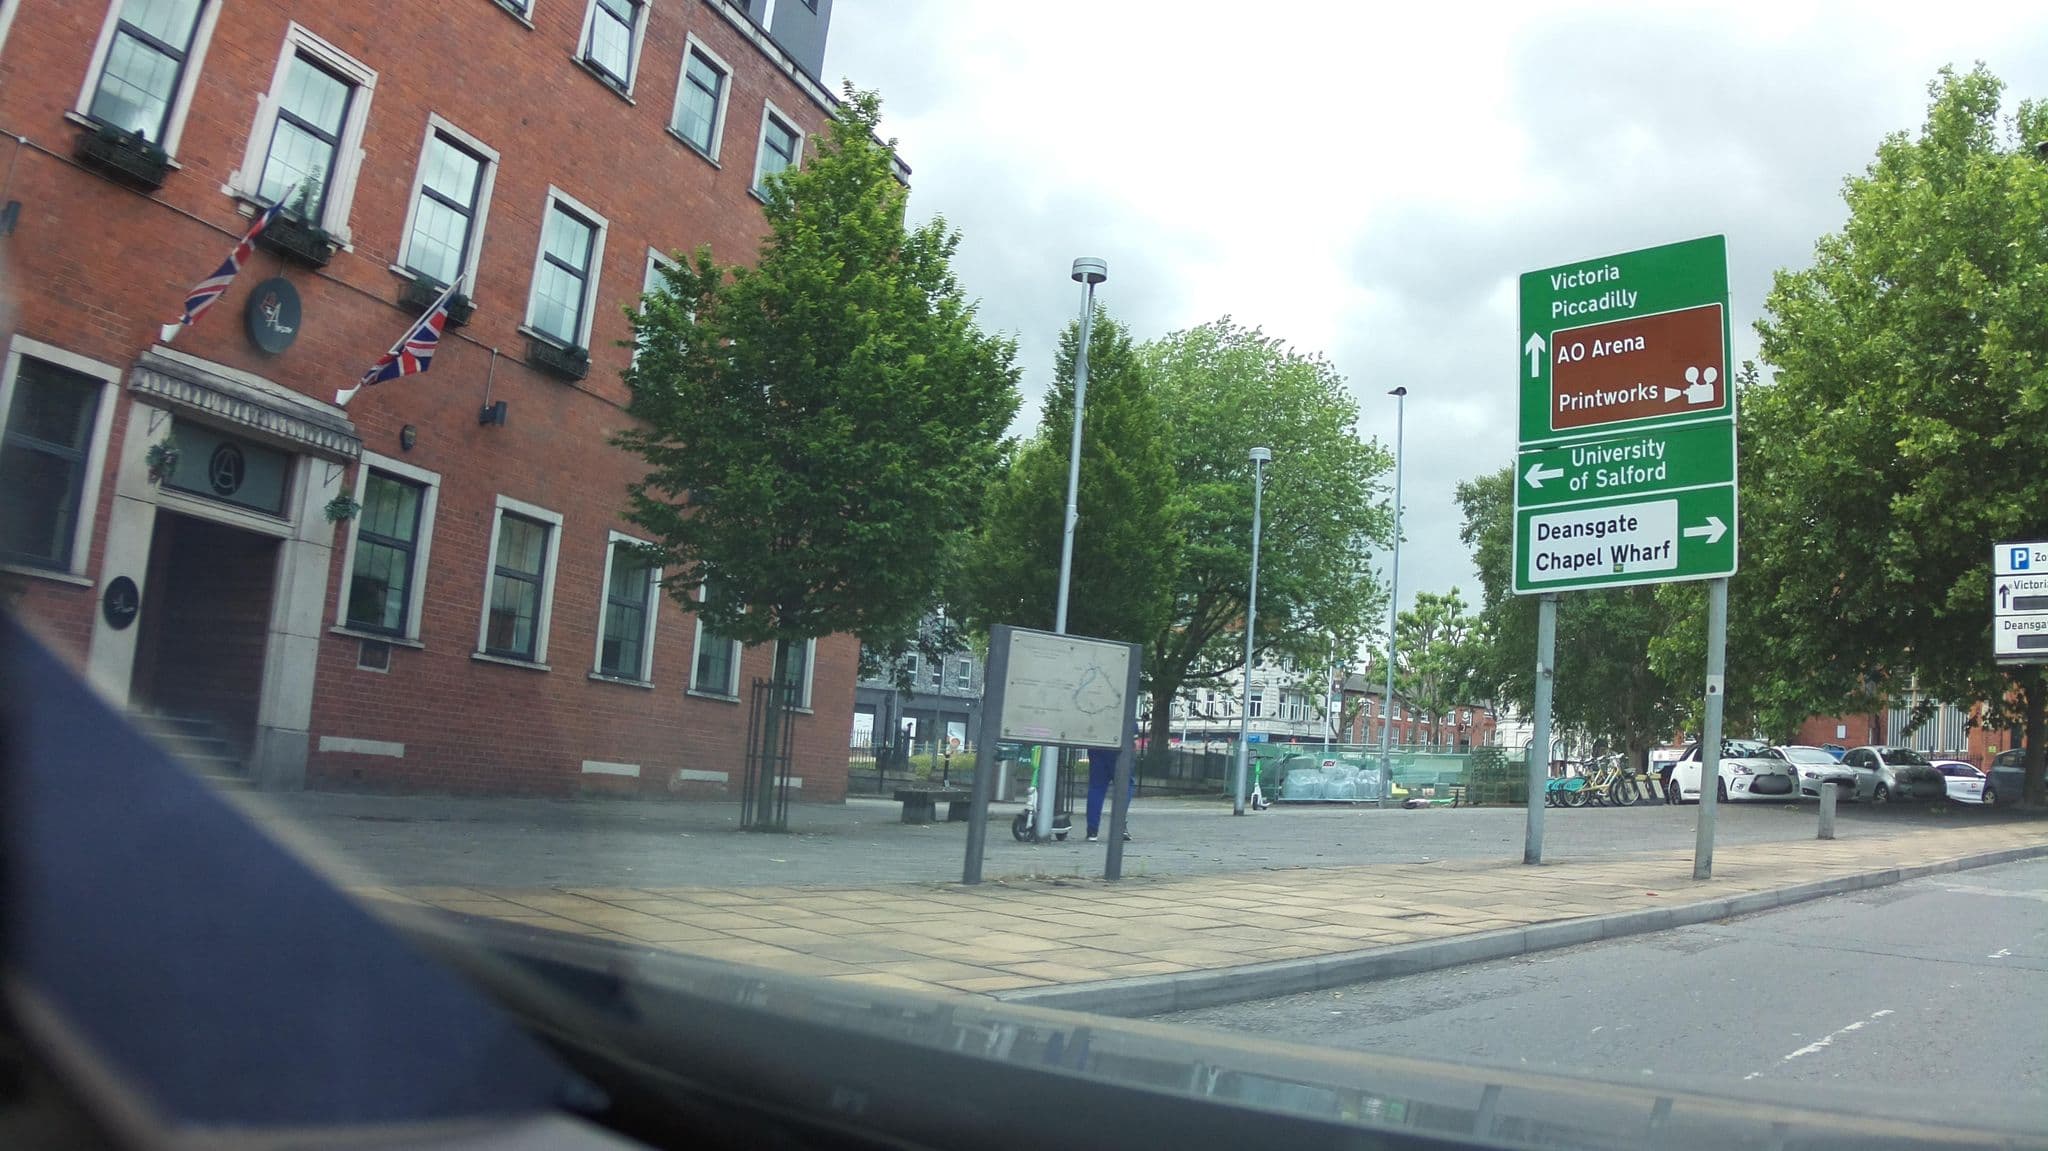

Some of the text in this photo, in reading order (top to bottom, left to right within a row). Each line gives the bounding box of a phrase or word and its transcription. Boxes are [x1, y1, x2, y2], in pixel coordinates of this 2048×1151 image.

[1550, 265, 1620, 290] Victoria
[1552, 289, 1638, 319] Piccadilly
[1557, 336, 1645, 364] AO Arena
[1559, 383, 1658, 412] Printworks
[1572, 438, 1666, 467] University
[1569, 461, 1667, 491] of Salford
[1537, 515, 1638, 541] Deansgate
[1536, 540, 1671, 571] Chapel Wharf
[2014, 549, 2028, 569] P
[2013, 579, 2048, 590] Victori
[2004, 620, 2048, 631] Deansga
